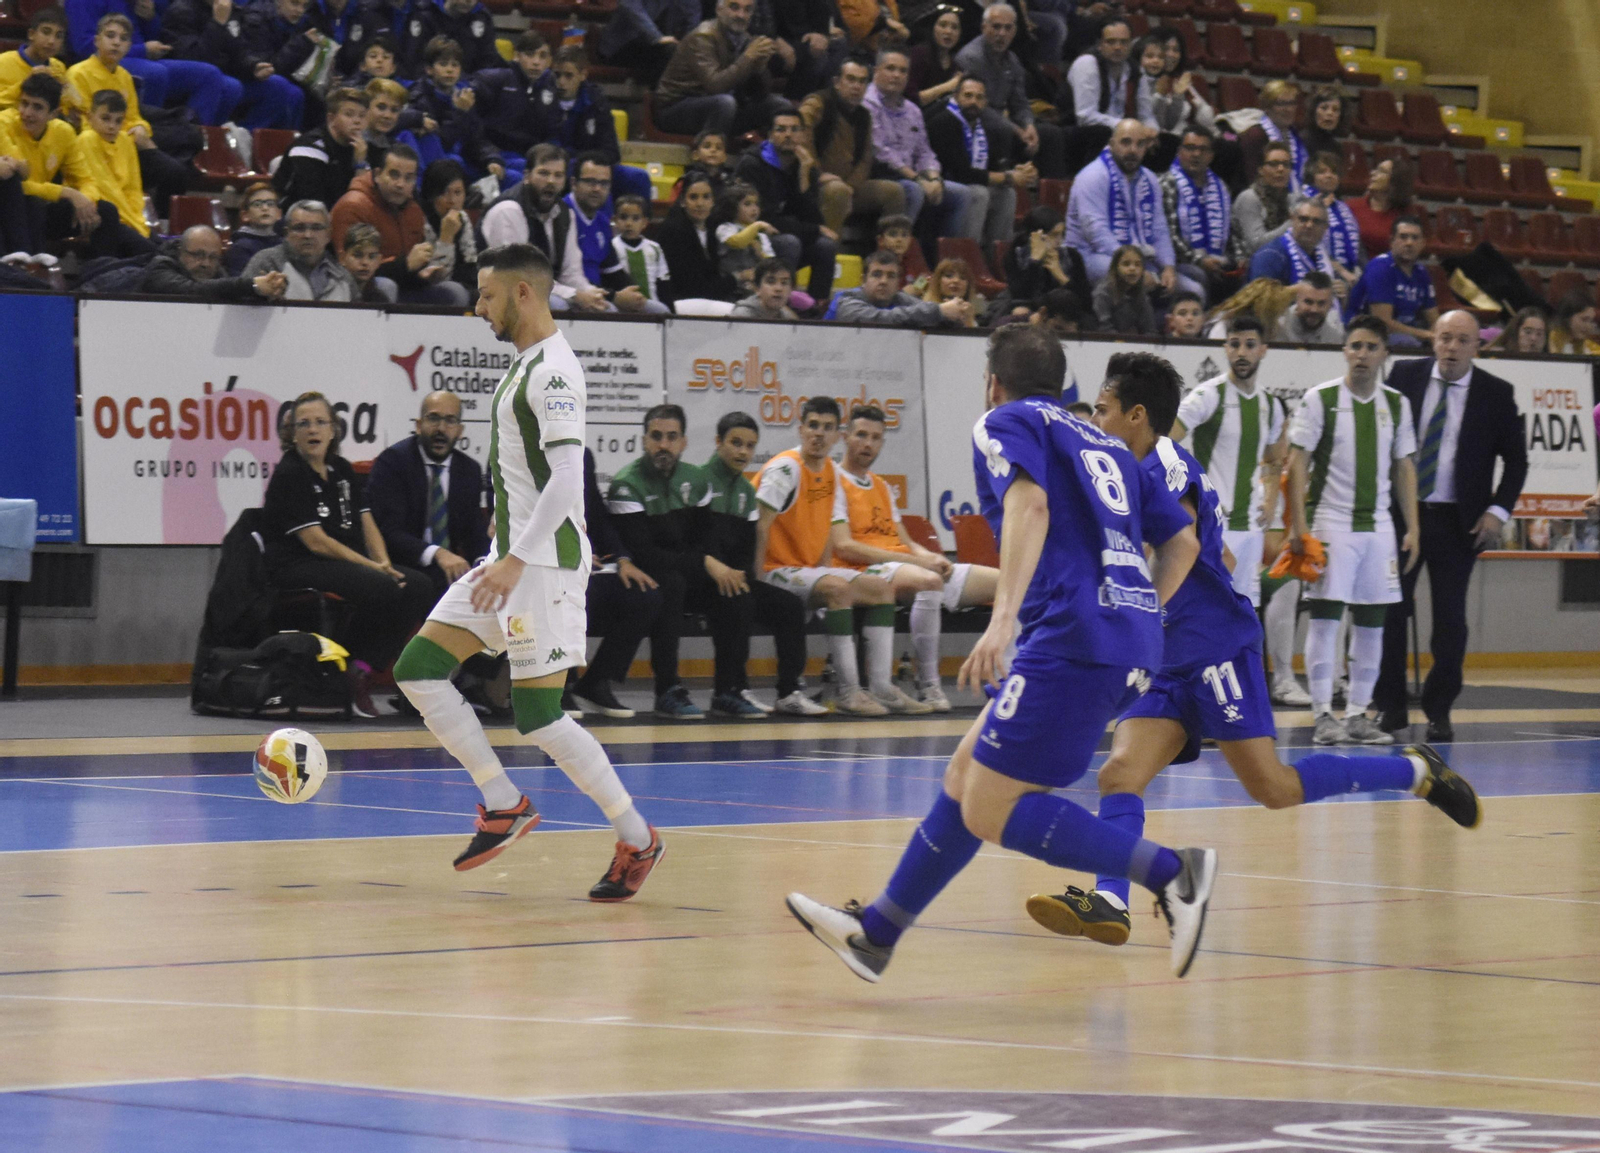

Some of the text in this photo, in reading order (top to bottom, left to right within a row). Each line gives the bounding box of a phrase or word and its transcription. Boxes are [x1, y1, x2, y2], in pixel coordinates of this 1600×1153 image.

[431, 346, 510, 368] Catalana
[1533, 389, 1582, 410] HOTEL
[134, 460, 197, 478] GRUPO
[1080, 449, 1130, 516] 8
[994, 674, 1026, 720] 8
[1202, 661, 1243, 705] 11
